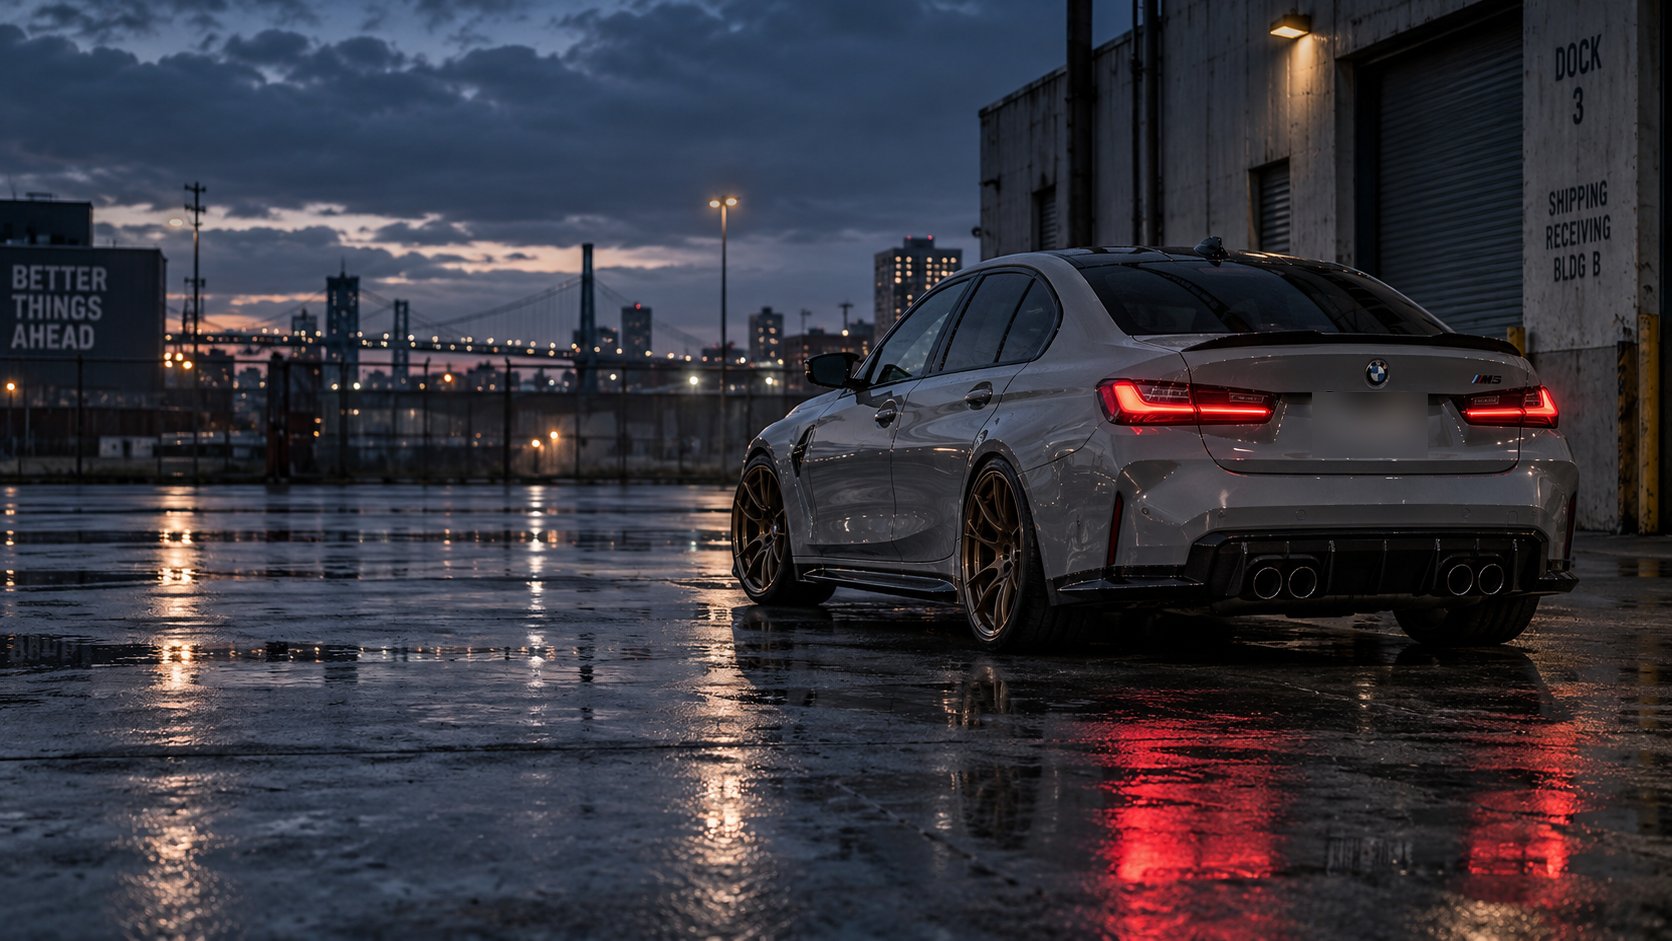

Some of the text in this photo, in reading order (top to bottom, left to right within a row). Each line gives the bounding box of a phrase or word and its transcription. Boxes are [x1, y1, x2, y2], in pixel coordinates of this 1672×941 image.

[1555, 34, 1602, 82] DOCK
[1572, 87, 1584, 125] 3
[1548, 180, 1608, 217] SHIPPING
[1546, 214, 1611, 250] RECEIVING
[12, 265, 108, 291] BETTER
[1554, 251, 1601, 282] BLDG B
[12, 294, 102, 321] THINGS
[11, 324, 94, 350] AHEAD
